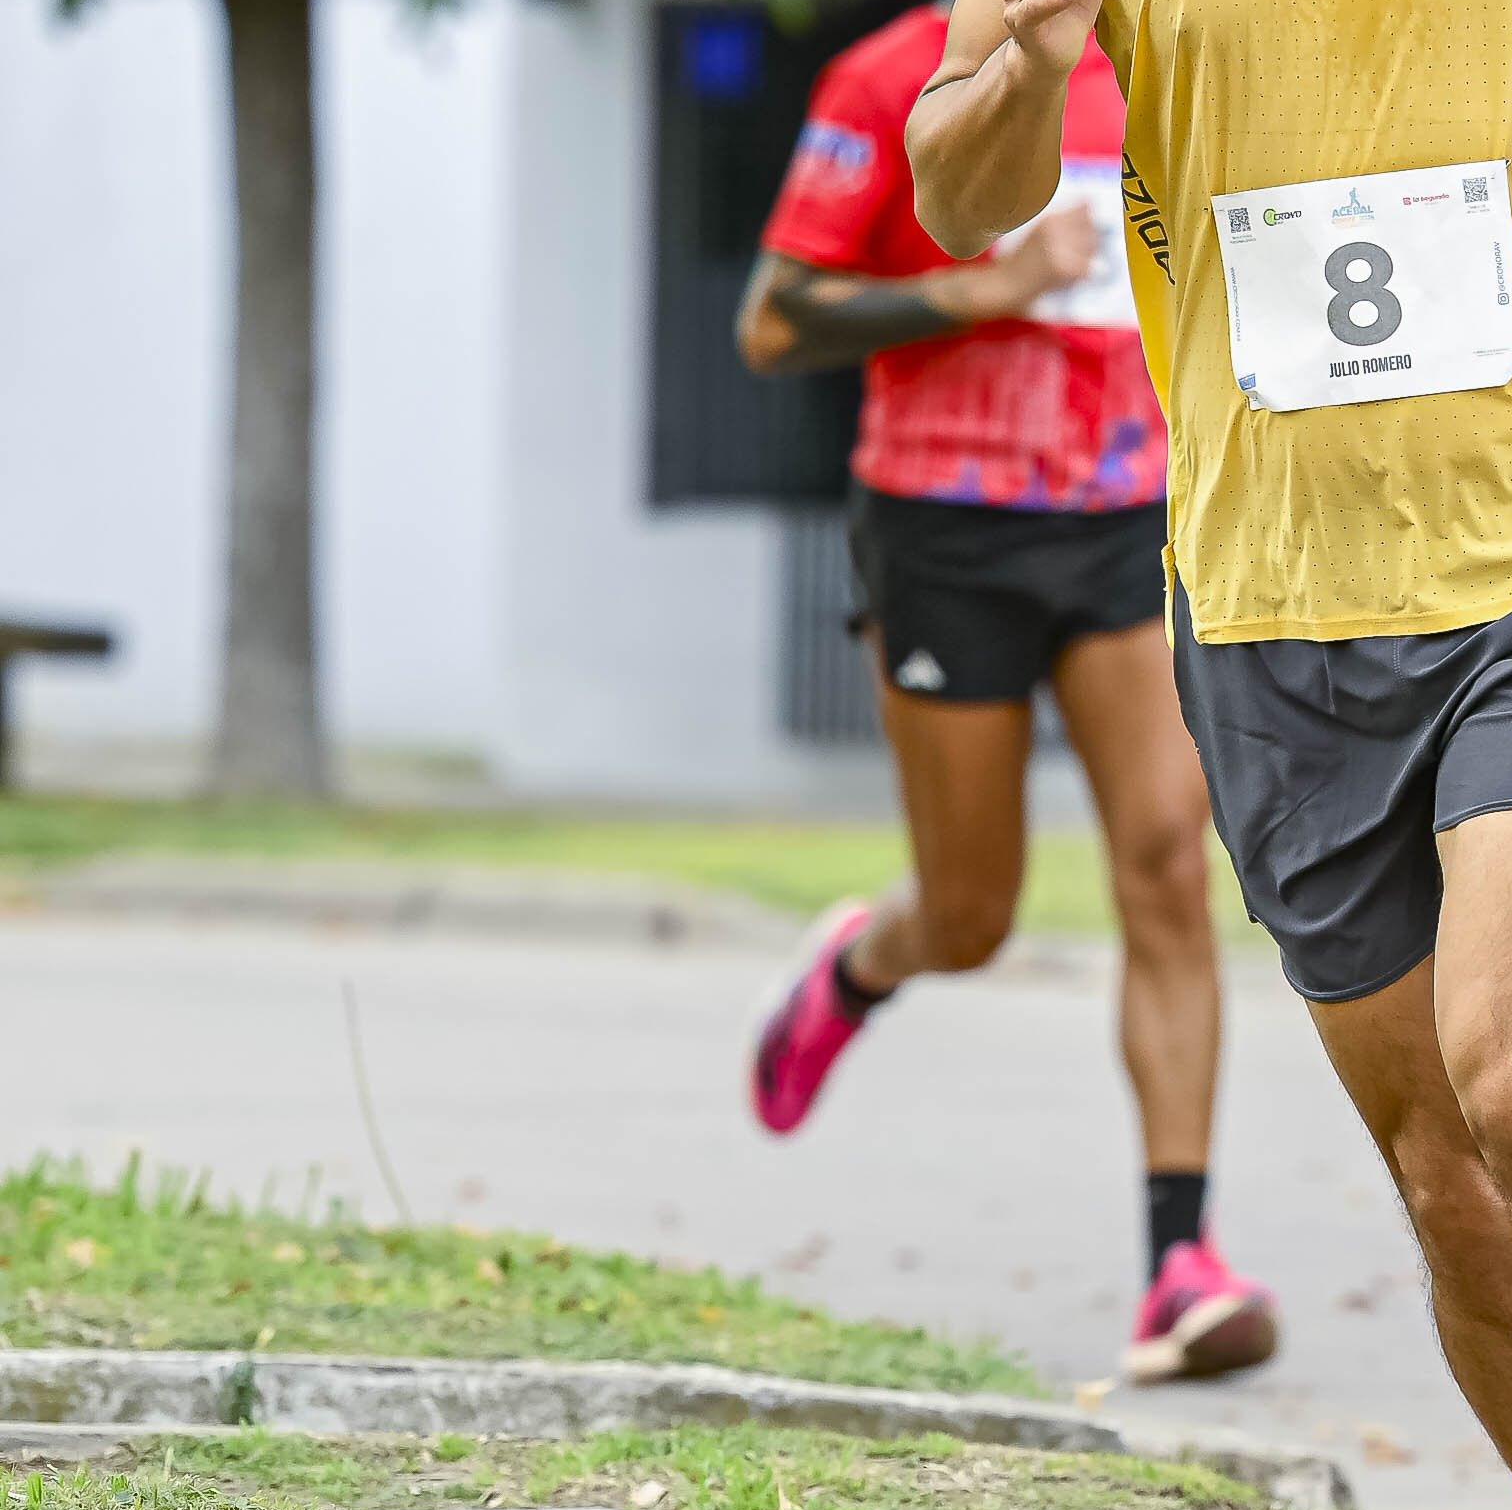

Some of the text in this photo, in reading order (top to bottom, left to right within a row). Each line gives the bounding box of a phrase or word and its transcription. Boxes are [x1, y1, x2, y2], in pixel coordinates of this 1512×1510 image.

[1324, 241, 1403, 347] 8
[1329, 354, 1412, 378] JULIO ROMERO
